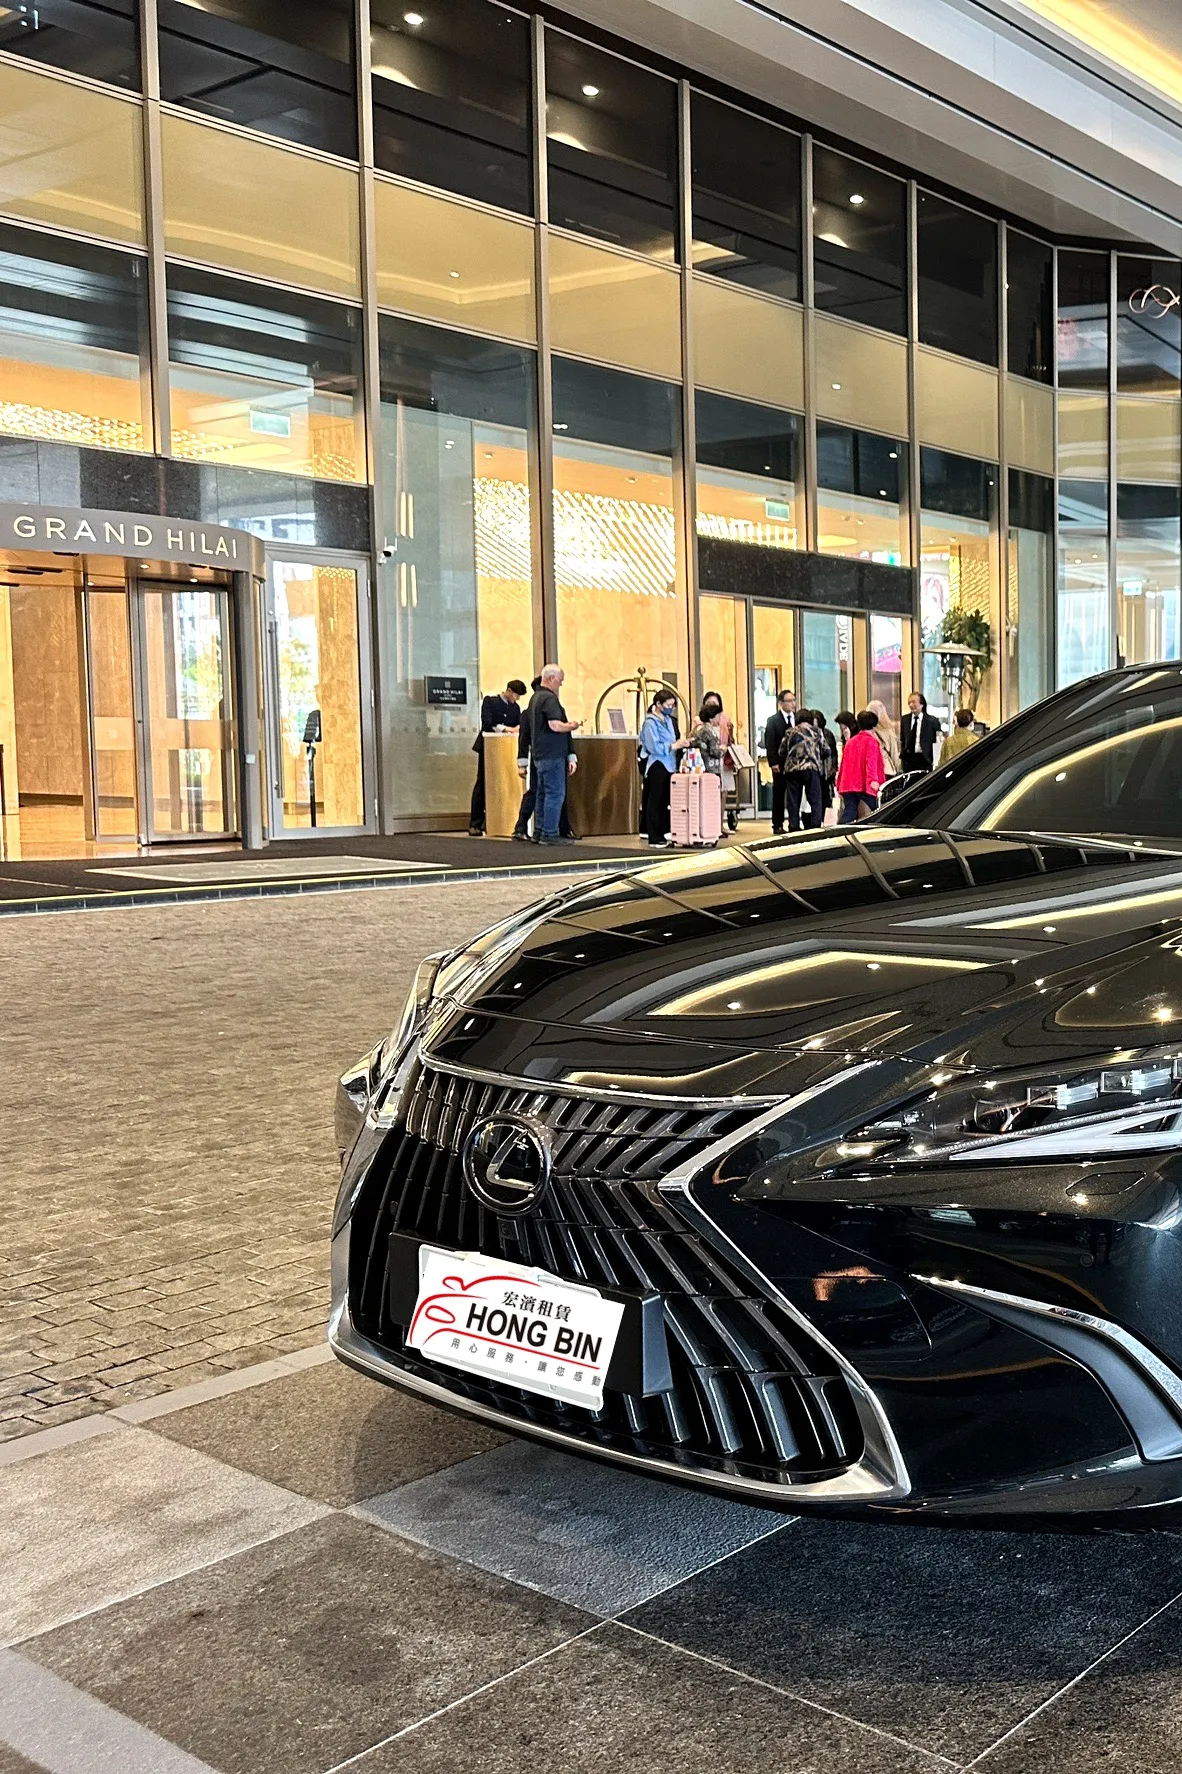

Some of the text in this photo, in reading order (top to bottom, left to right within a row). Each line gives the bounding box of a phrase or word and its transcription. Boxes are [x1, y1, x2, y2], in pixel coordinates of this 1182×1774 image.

[13, 515, 238, 559] GRAND HILAI
[501, 1290, 572, 1323] 宏濱租賃
[465, 1303, 603, 1363] HONG BIN
